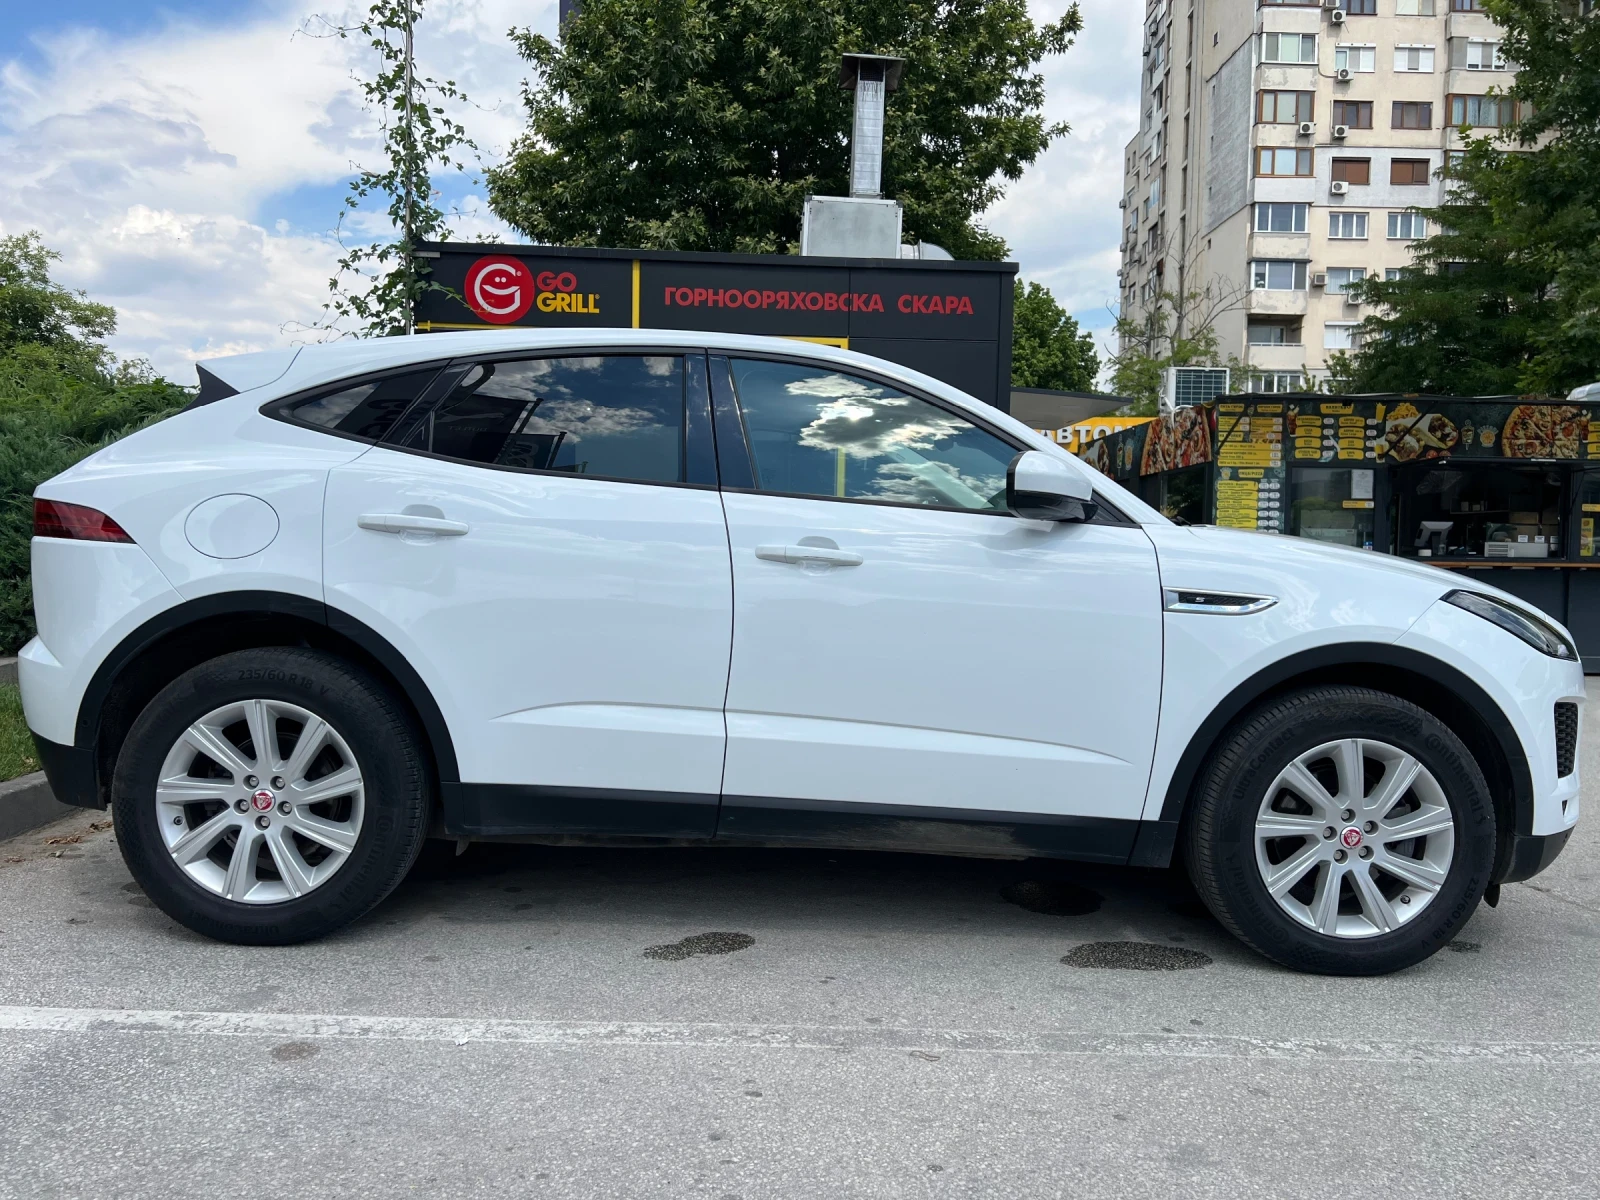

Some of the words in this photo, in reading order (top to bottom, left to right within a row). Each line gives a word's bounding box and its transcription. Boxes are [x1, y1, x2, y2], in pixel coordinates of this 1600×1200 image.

[537, 271, 577, 292] GO
[664, 286, 885, 313] ГОРНООРЯХОВСКА
[897, 294, 974, 315] СКАРА
[238, 668, 286, 681] 235/60
[288, 673, 298, 684] R
[299, 677, 313, 690] 18
[319, 685, 330, 696] V
[1232, 727, 1296, 800] UltraContact
[1425, 733, 1484, 814] Continental
[1452, 877, 1480, 919] 235/60
[1432, 927, 1446, 939] 18
[1444, 918, 1455, 929] R
